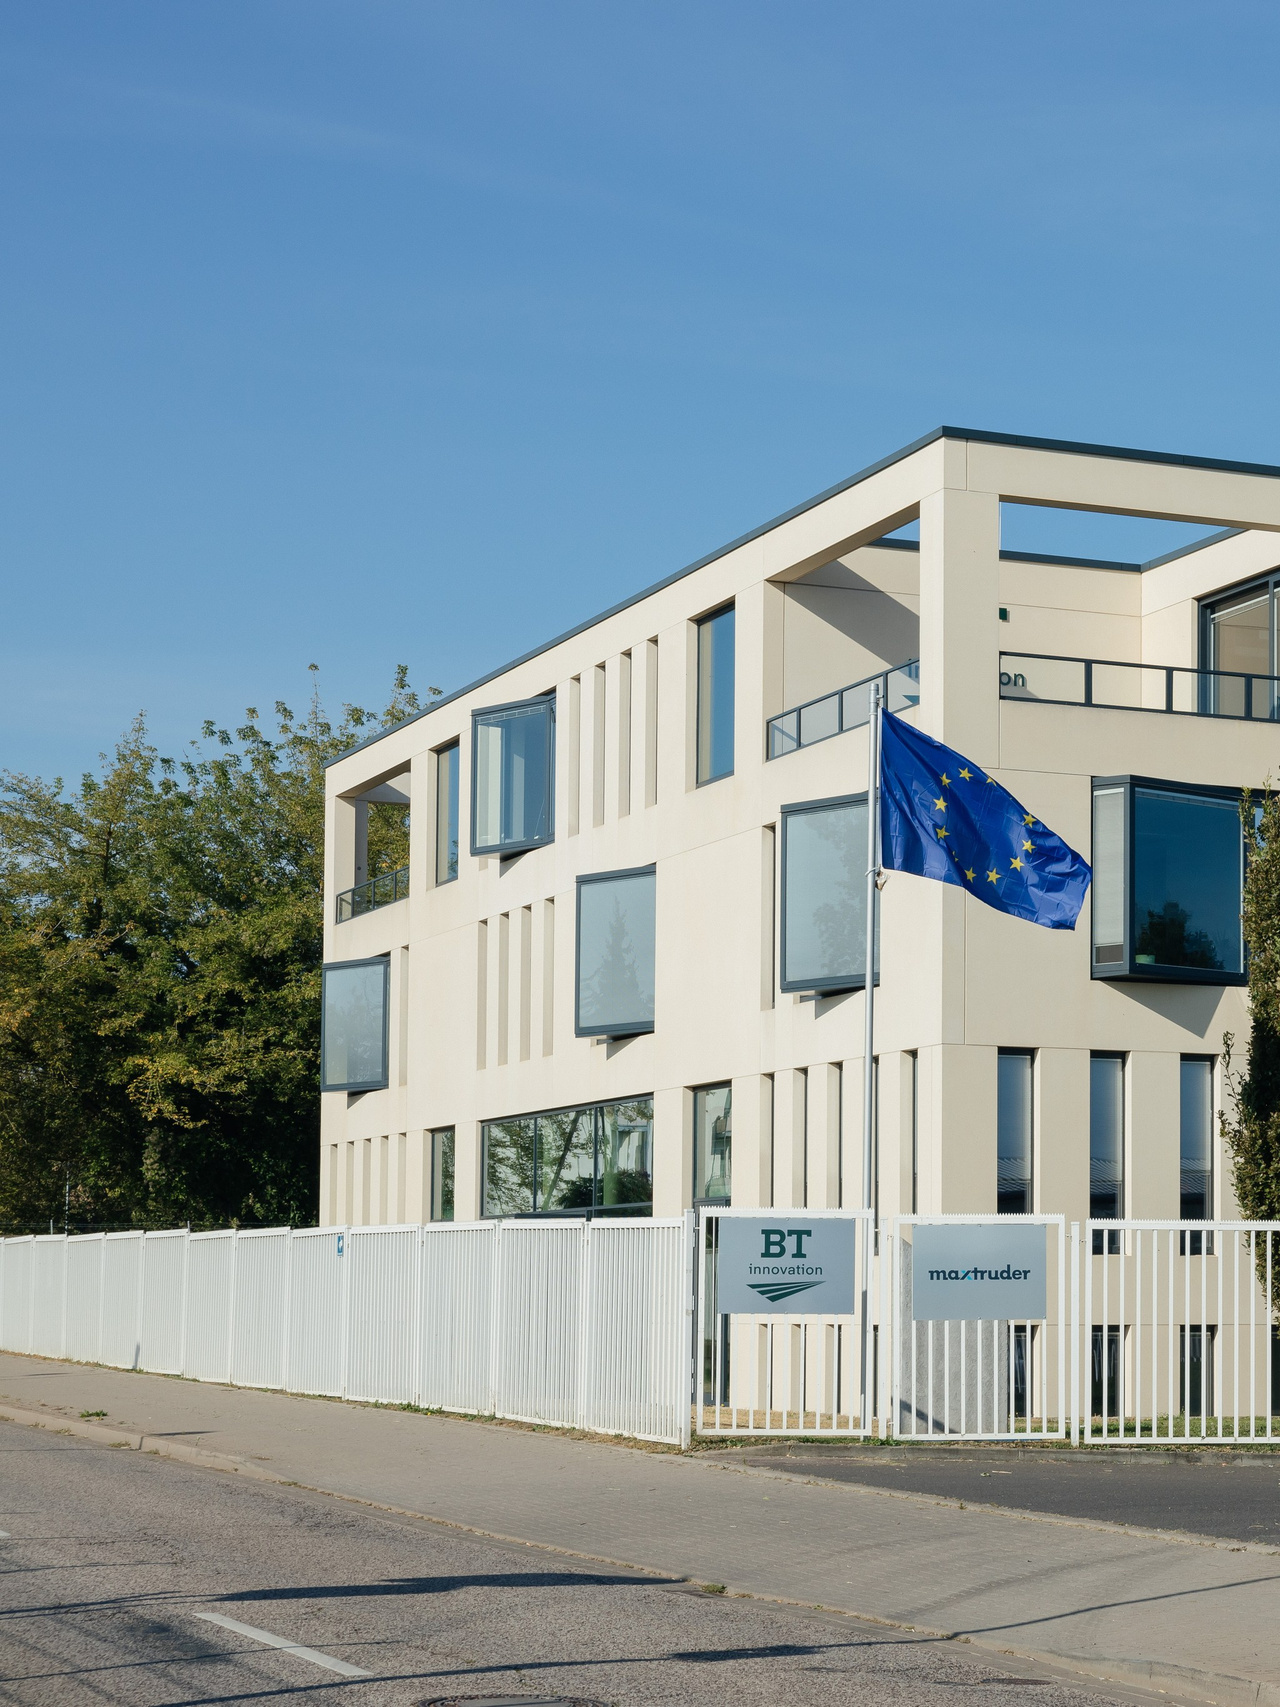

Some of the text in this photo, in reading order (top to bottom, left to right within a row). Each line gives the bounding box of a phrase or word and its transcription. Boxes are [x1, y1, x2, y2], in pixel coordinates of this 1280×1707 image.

[761, 1229, 812, 1258] BT
[749, 1263, 823, 1275] innovation
[928, 1264, 1031, 1281] maxtruder
